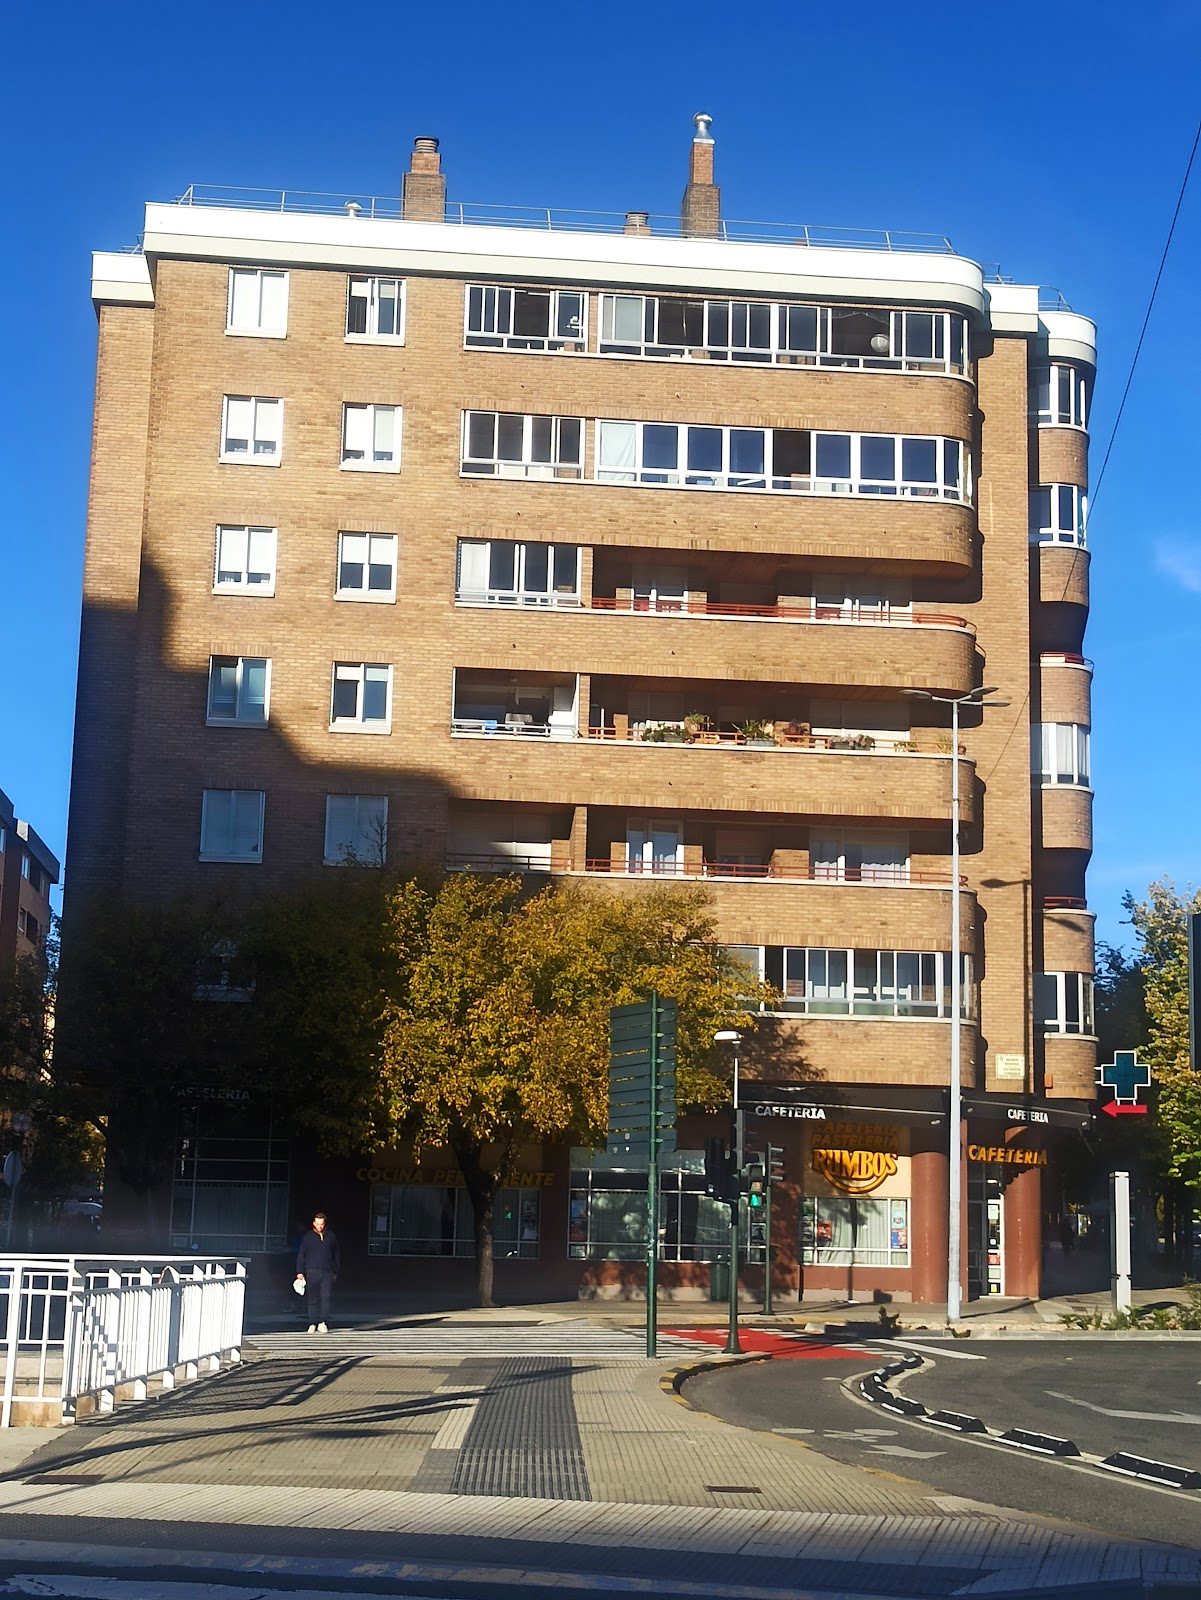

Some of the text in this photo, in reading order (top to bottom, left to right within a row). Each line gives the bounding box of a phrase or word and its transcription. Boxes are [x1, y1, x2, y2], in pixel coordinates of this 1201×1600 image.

[755, 1105, 826, 1120] CAFETERIA
[1007, 1108, 1049, 1123] CAFETERIA
[811, 1134, 898, 1148] PASTELERIA
[967, 1144, 1048, 1165] CAFETERIA
[812, 1149, 898, 1180] RUMBOS
[355, 1167, 556, 1187] COCINA PERENTE
